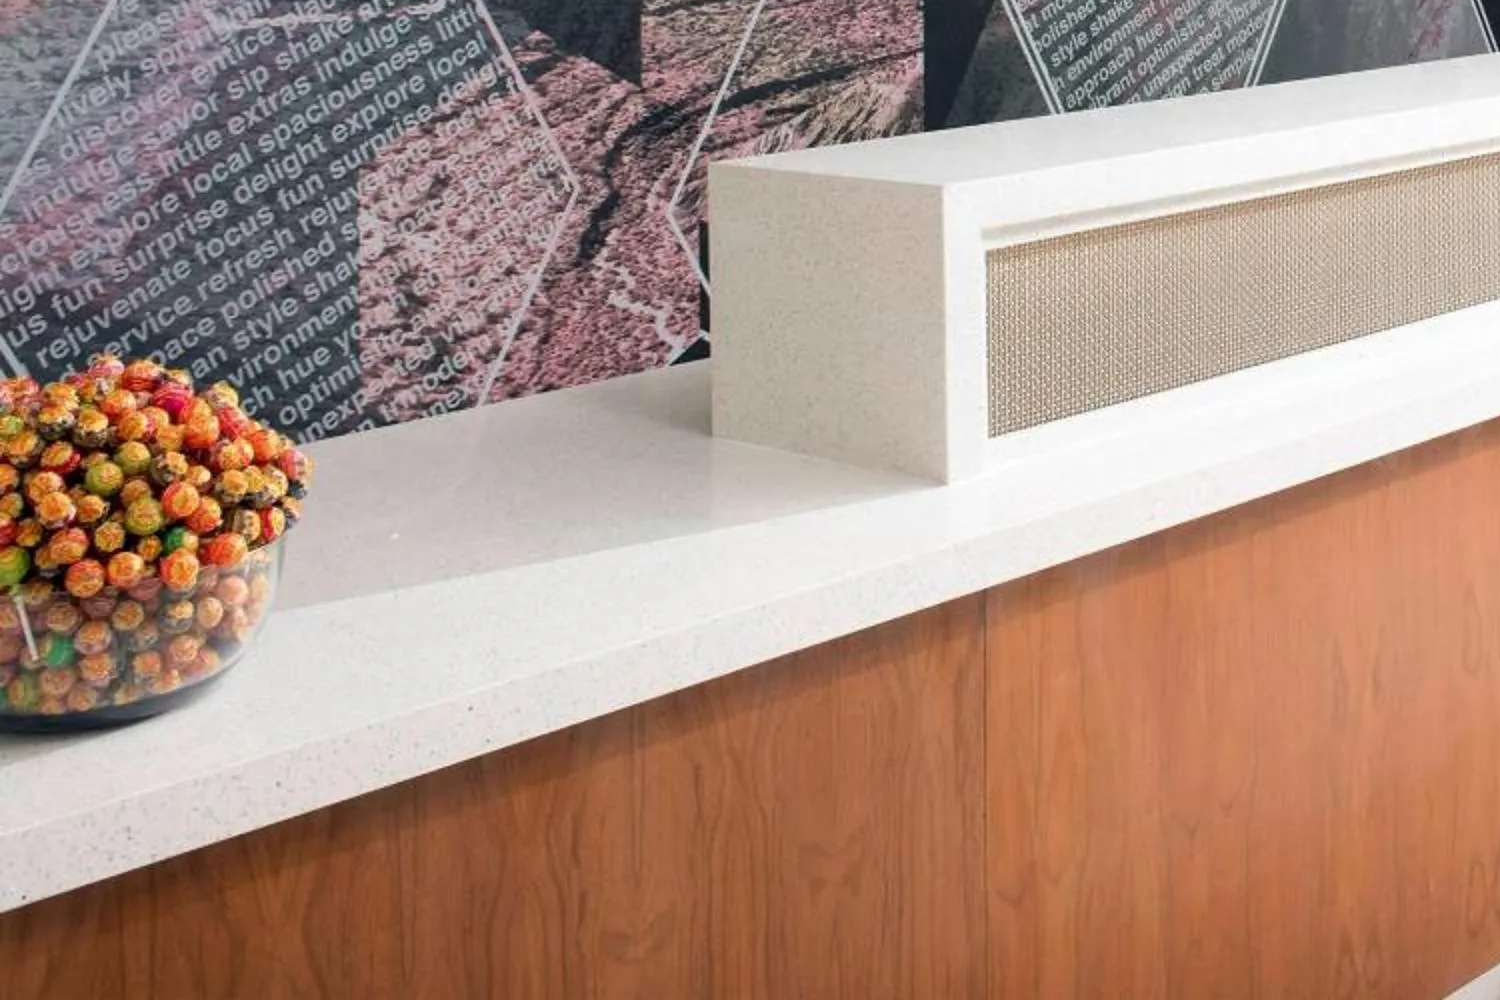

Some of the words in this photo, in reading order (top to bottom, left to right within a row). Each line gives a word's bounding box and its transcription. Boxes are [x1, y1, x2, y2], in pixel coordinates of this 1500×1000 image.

[49, 69, 131, 128] lively
[139, 91, 219, 151] savor
[225, 65, 269, 100] sip
[273, 15, 354, 72] shake
[155, 130, 222, 178] little
[227, 75, 312, 135] extras
[312, 15, 411, 83] indulge
[190, 26, 275, 84] entice
[49, 277, 106, 319] fun
[108, 198, 228, 282] surprise
[233, 132, 328, 203] delight
[330, 74, 426, 143] explore
[425, 28, 488, 82] local
[69, 193, 180, 269] explore
[180, 140, 254, 199] local
[257, 35, 433, 153] spaciousness
[34, 259, 191, 369] rejuvenate
[193, 205, 274, 265] focus
[276, 173, 325, 212] fun
[328, 104, 432, 179] surprise
[195, 227, 296, 302] refresh
[218, 230, 336, 329] polished
[232, 297, 298, 350] style
[275, 346, 330, 391] hue
